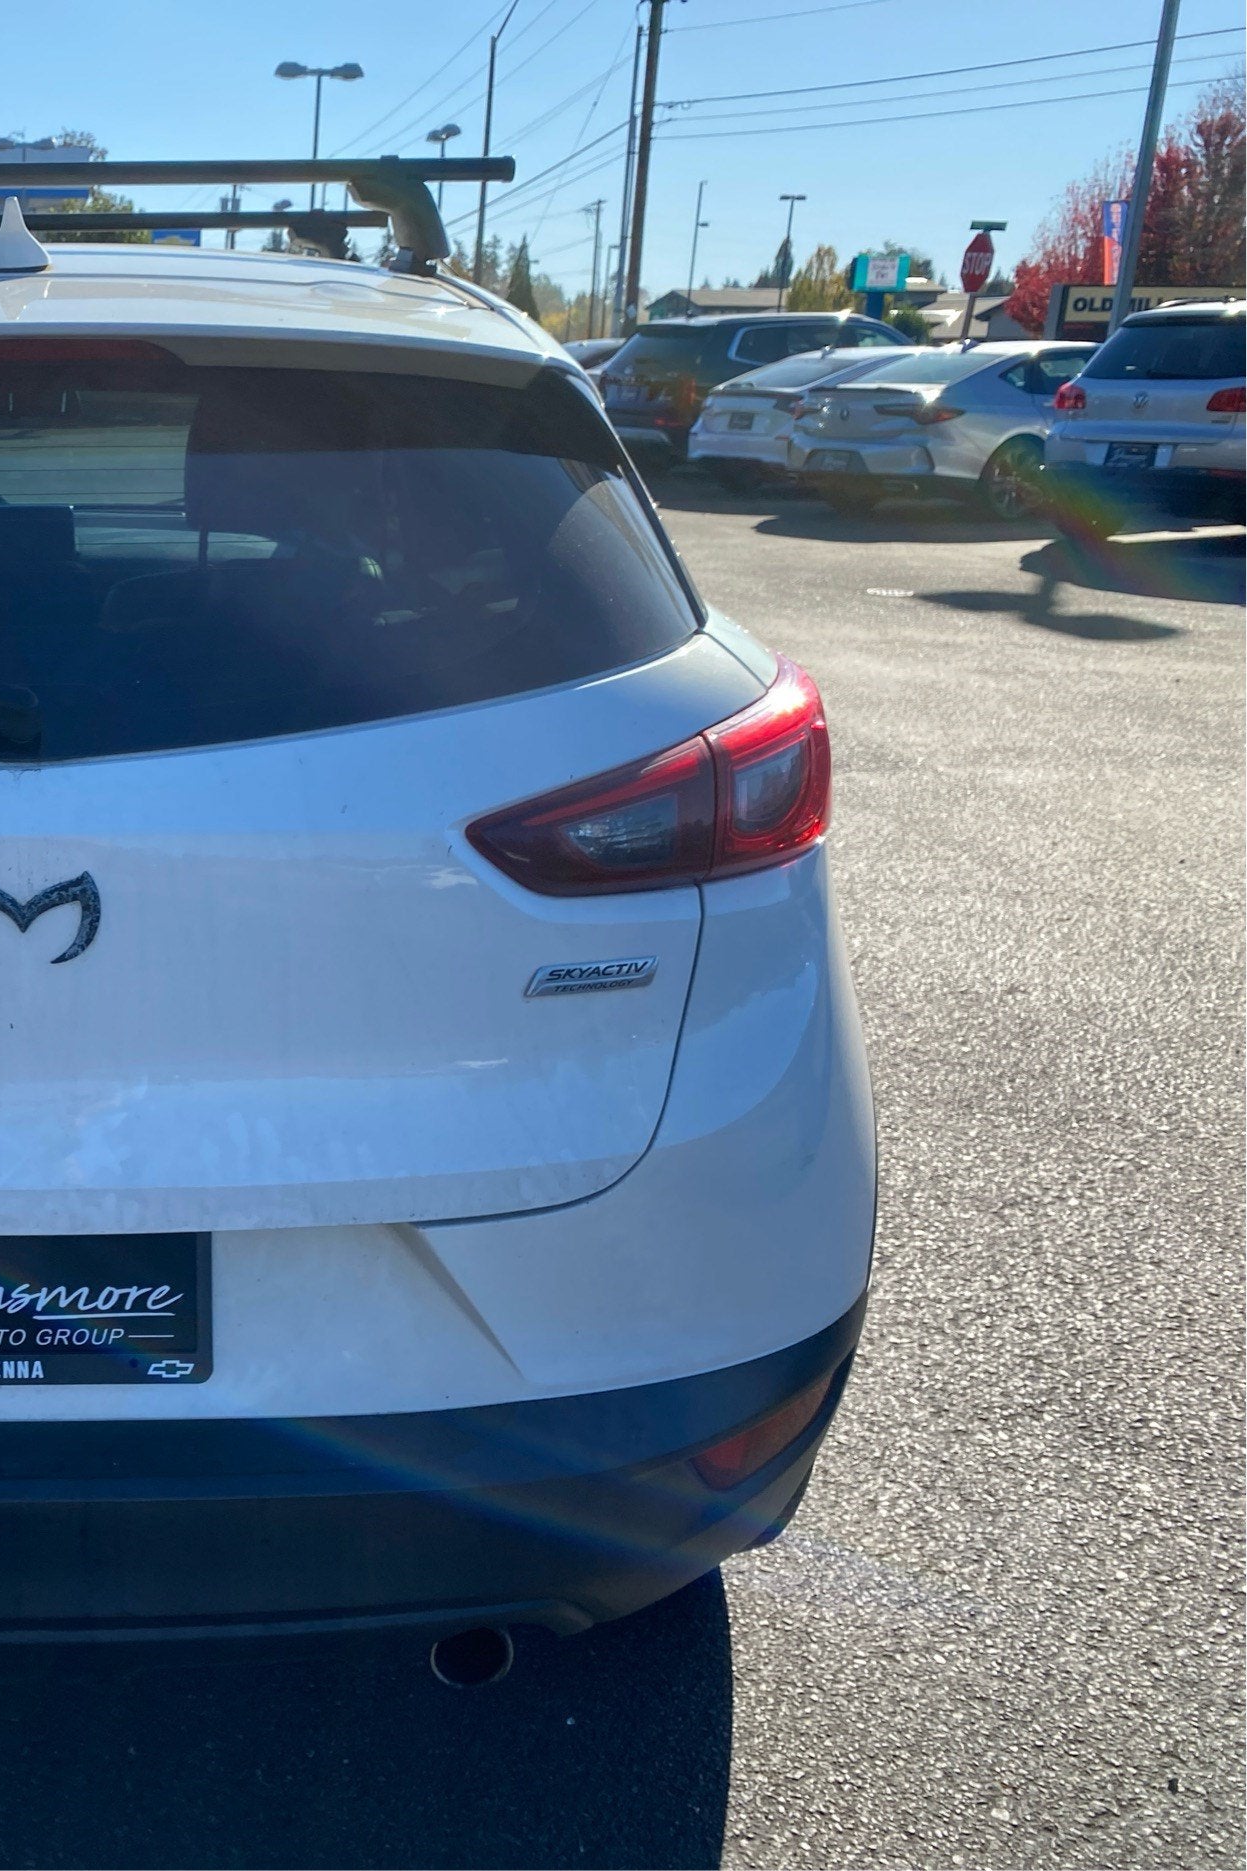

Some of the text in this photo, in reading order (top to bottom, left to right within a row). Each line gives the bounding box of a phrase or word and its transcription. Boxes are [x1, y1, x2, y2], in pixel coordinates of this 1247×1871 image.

[963, 252, 991, 276] STOP
[1072, 297, 1113, 312] OLD
[546, 961, 649, 981] SKYACTIV
[554, 980, 635, 993] TECHNOLOGY
[36, 1328, 125, 1346] GROUP
